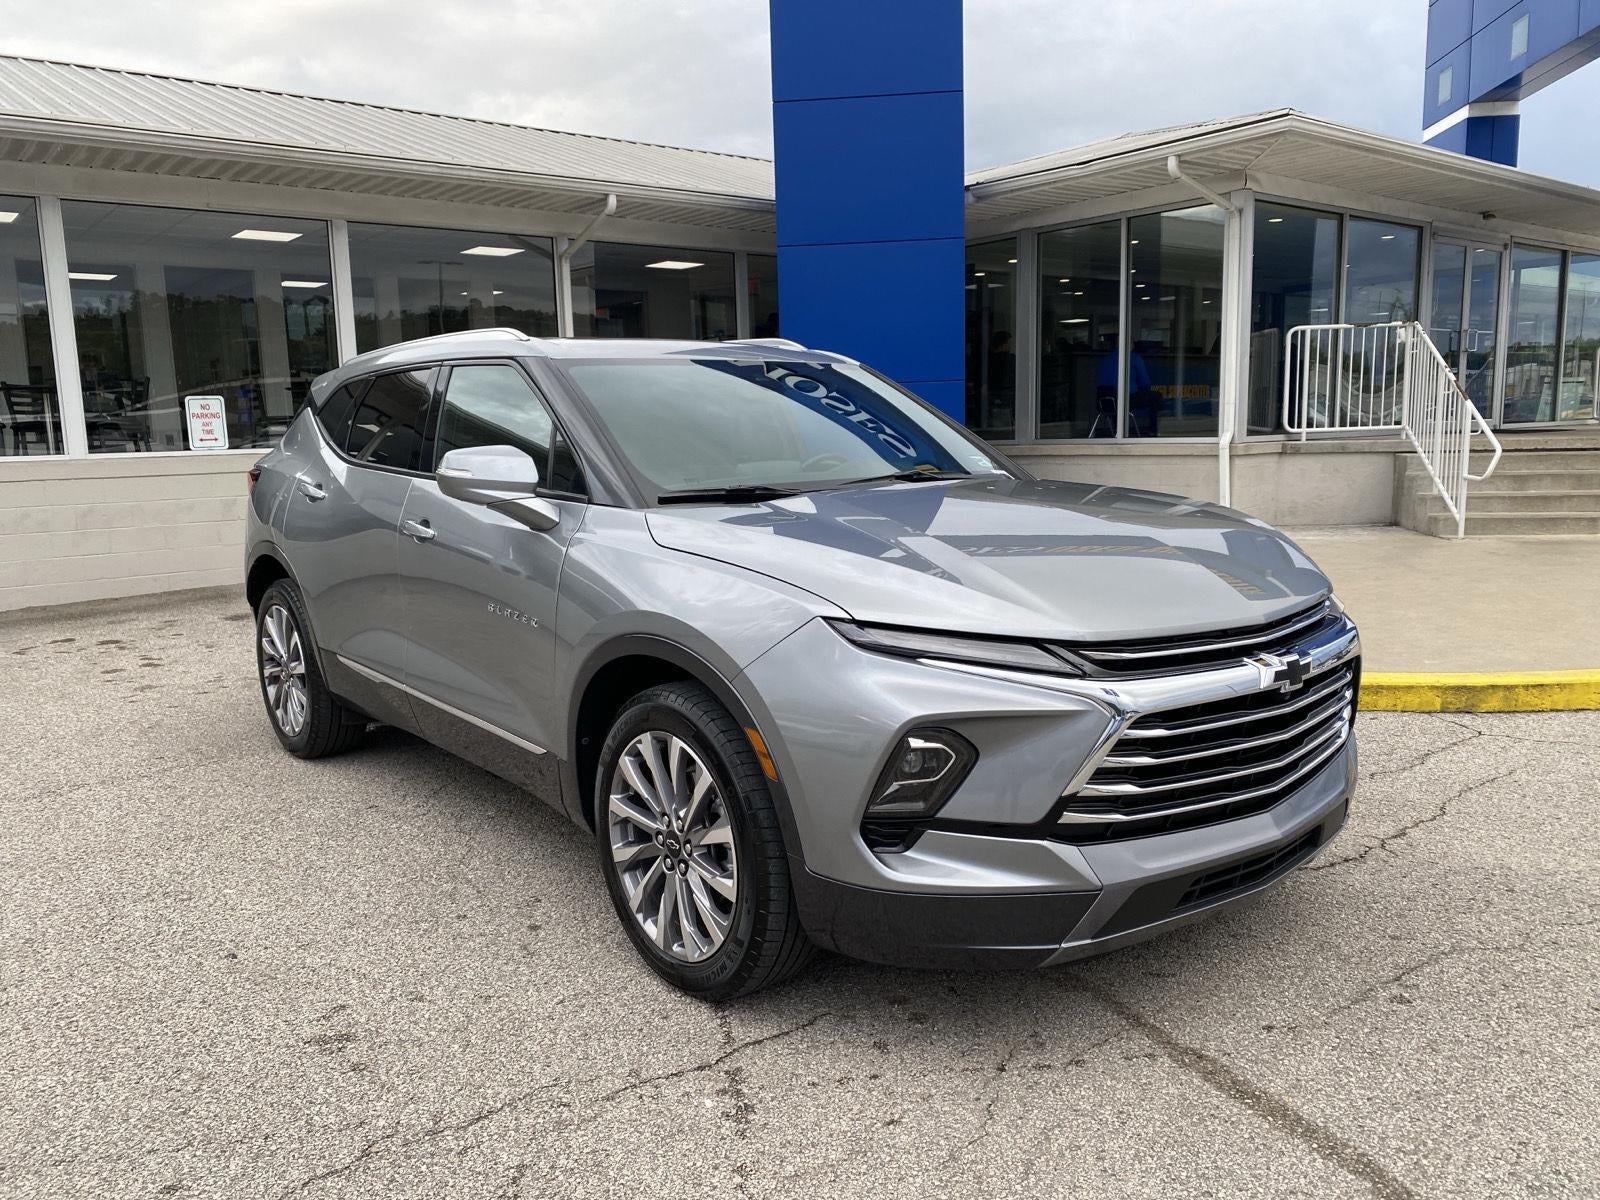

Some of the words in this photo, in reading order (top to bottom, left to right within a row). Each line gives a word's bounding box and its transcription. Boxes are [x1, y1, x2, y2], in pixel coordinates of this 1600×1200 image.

[200, 403, 211, 411] NO
[191, 412, 220, 420] PARKING
[487, 603, 538, 628] BLAZER
